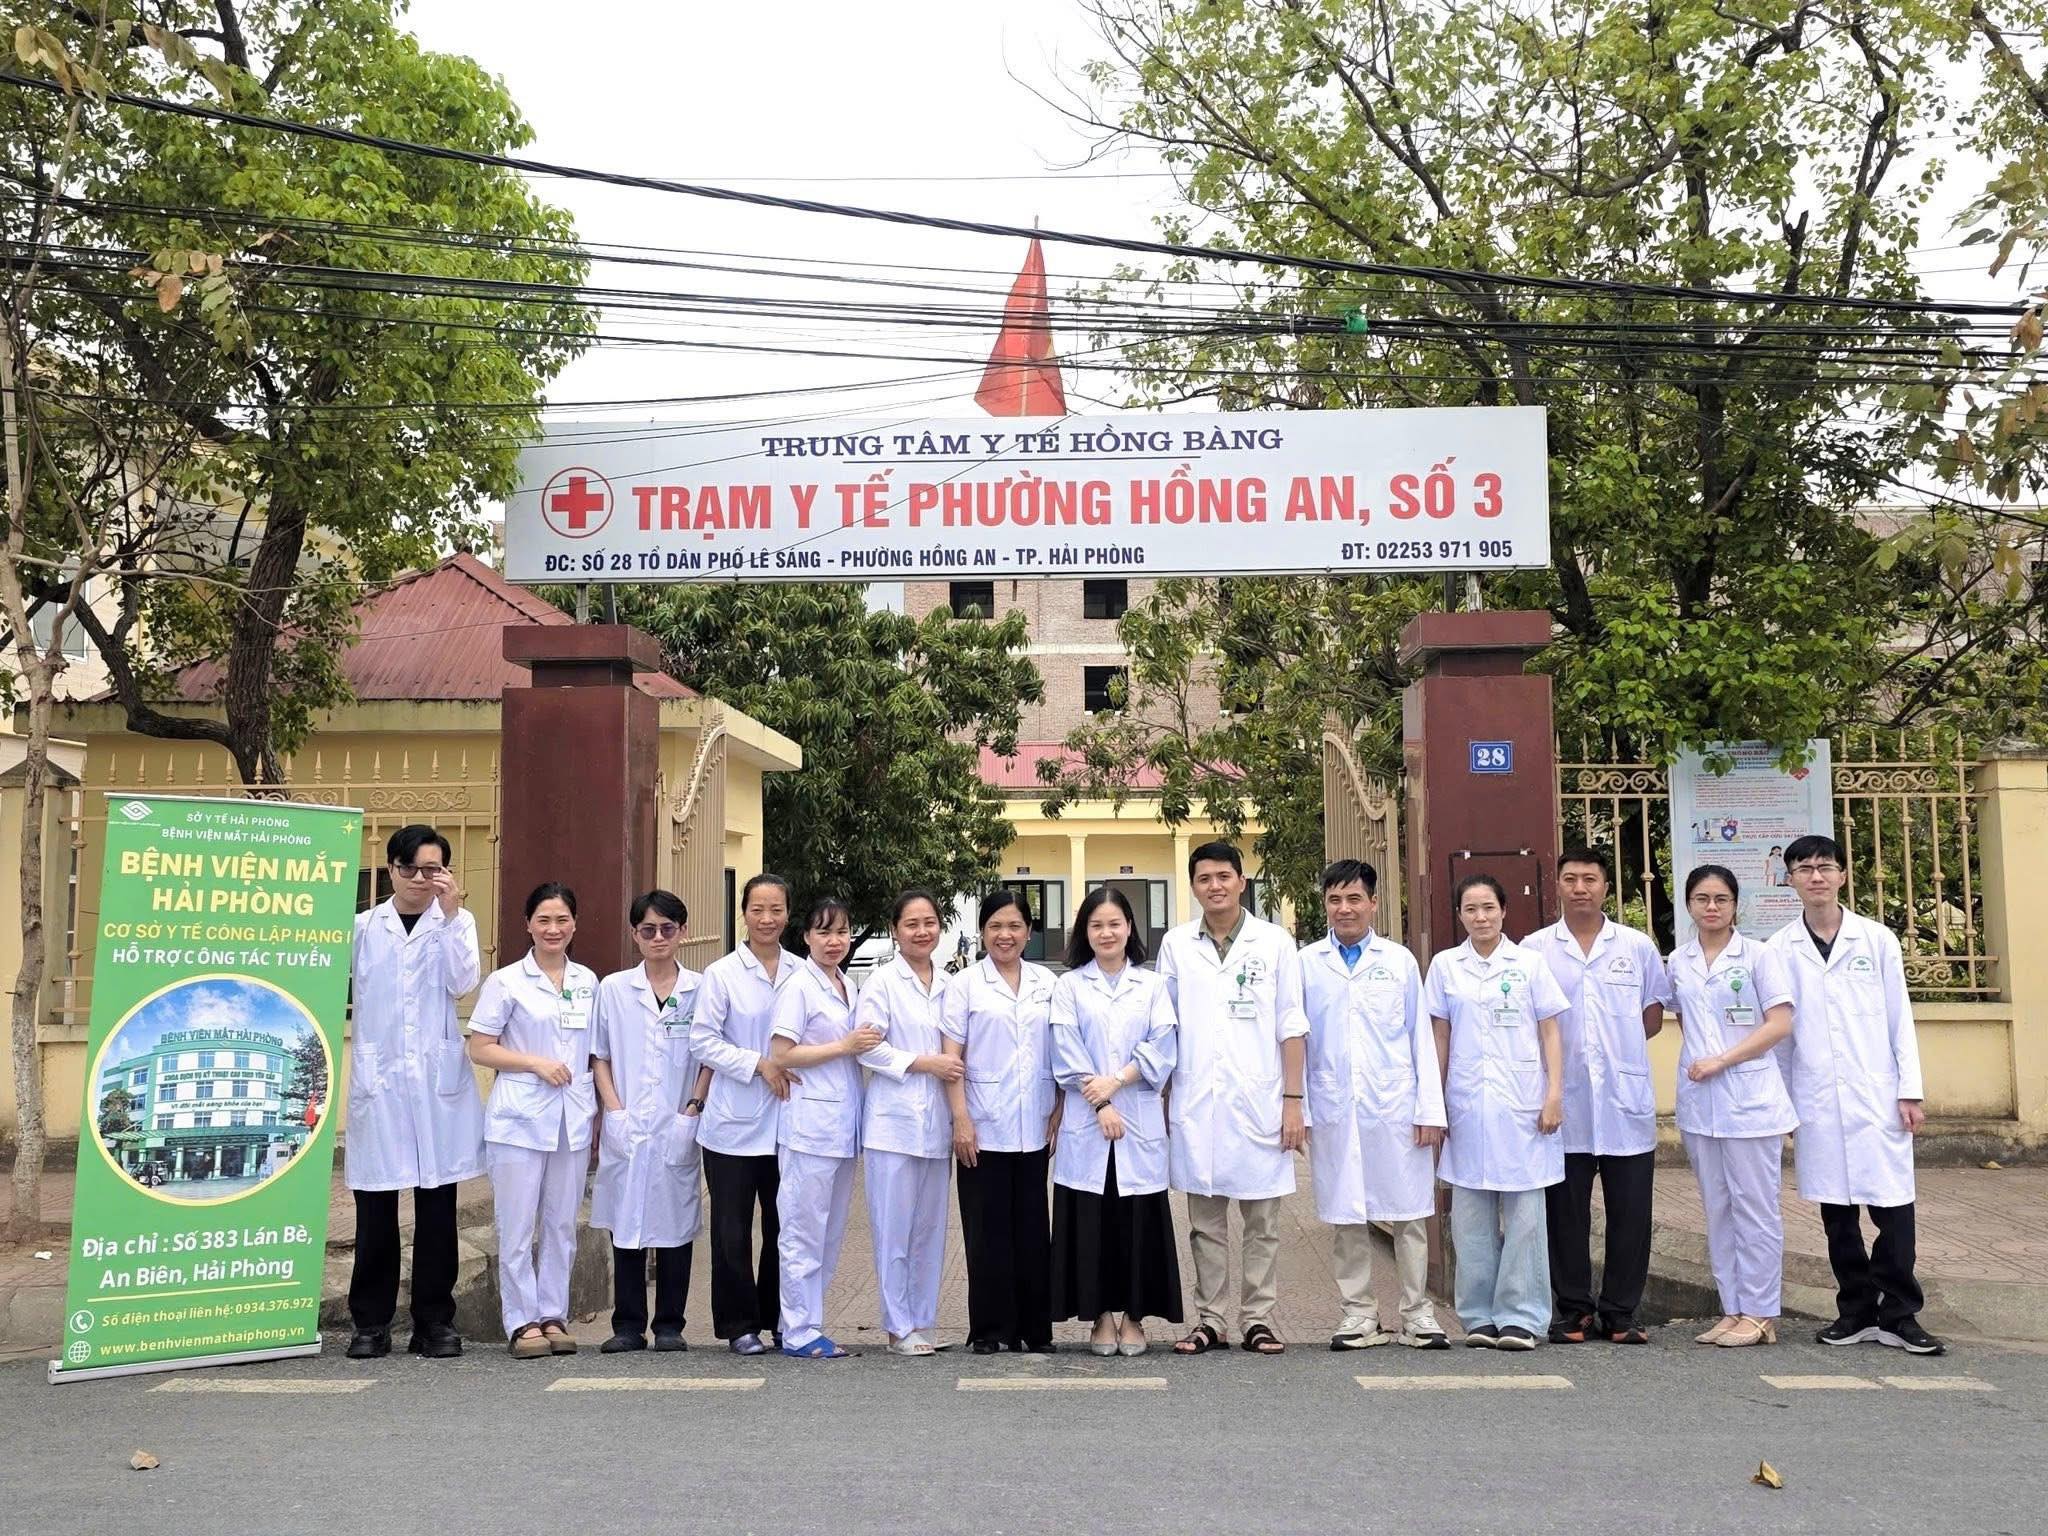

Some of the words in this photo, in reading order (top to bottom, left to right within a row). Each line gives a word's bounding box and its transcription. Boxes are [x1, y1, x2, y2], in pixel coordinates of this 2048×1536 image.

[762, 436, 884, 457] TRUNG
[893, 431, 969, 456] TÂM
[979, 434, 1006, 454] Y
[1015, 426, 1060, 454] TẾ
[1070, 423, 1173, 453] HỒNG
[1184, 424, 1283, 451] BÀNG
[632, 485, 772, 540] TRẠM
[790, 484, 817, 529] Y
[835, 468, 894, 528] TẾ
[908, 469, 1112, 527] PHƯỜNG
[1130, 463, 1267, 525] HỒNG
[1284, 475, 1371, 527] AN,
[1390, 456, 1458, 519] SỐ
[1474, 473, 1503, 518] 3
[545, 554, 575, 572] ĐC:
[582, 548, 606, 571] SỐ
[610, 553, 632, 571] 28
[638, 546, 661, 570] TỔ
[667, 549, 701, 570] DÂN
[708, 545, 745, 570] PHỐ
[750, 548, 771, 568] LÊ
[841, 545, 914, 568] PHƯỜNG
[918, 542, 967, 567] HỒNG
[973, 548, 997, 566] AN
[1015, 548, 1043, 566] TP.
[1049, 543, 1078, 565] HẢI
[1084, 544, 1145, 565] PHÒNG
[1341, 543, 1371, 560] ĐT:
[1376, 541, 1433, 560] 02253
[1439, 541, 1471, 559] 971
[1478, 540, 1513, 558] 905
[1477, 747, 1506, 767] 28
[186, 811, 202, 823] SỞ
[206, 814, 213, 824] Y
[214, 813, 228, 824] TẾ
[230, 814, 249, 825] HẢI
[251, 816, 290, 828] PHÒNG
[161, 826, 193, 841] BỆNH
[196, 828, 222, 842] VIỆN
[250, 831, 270, 843] HẢI
[272, 834, 312, 846] PHÒNG
[120, 846, 204, 882] BỆNH
[211, 851, 281, 886] VIỆN
[284, 850, 348, 884] MẮT
[152, 880, 205, 913] HẢI
[210, 886, 315, 917] PHÒNG
[103, 923, 133, 939] CƠ
[135, 920, 163, 940] SỞ
[166, 924, 178, 941] Y
[181, 921, 204, 941] TẾ
[206, 923, 256, 943] CÔNG
[258, 925, 292, 947] LẬP
[294, 928, 344, 947] HẠNG
[112, 941, 140, 964] HỖ
[143, 948, 182, 968] TRỢ
[239, 947, 270, 967] TÁC
[276, 945, 332, 968] TUYẾN
[82, 1235, 118, 1261] Địa
[124, 1232, 158, 1256] chỉ
[172, 1230, 198, 1252] Số
[200, 1229, 239, 1251] 383
[243, 1226, 279, 1247] Lán
[283, 1223, 314, 1246] Bè,
[99, 1268, 131, 1289] An
[136, 1265, 190, 1288] Biên,
[193, 1261, 227, 1283] Hải
[231, 1258, 294, 1280] Phòng
[102, 1312, 119, 1328] Số
[122, 1310, 151, 1328] điện
[153, 1307, 188, 1325] thoại
[100, 1325, 305, 1356] www.benhvienmathaiphong.vn
